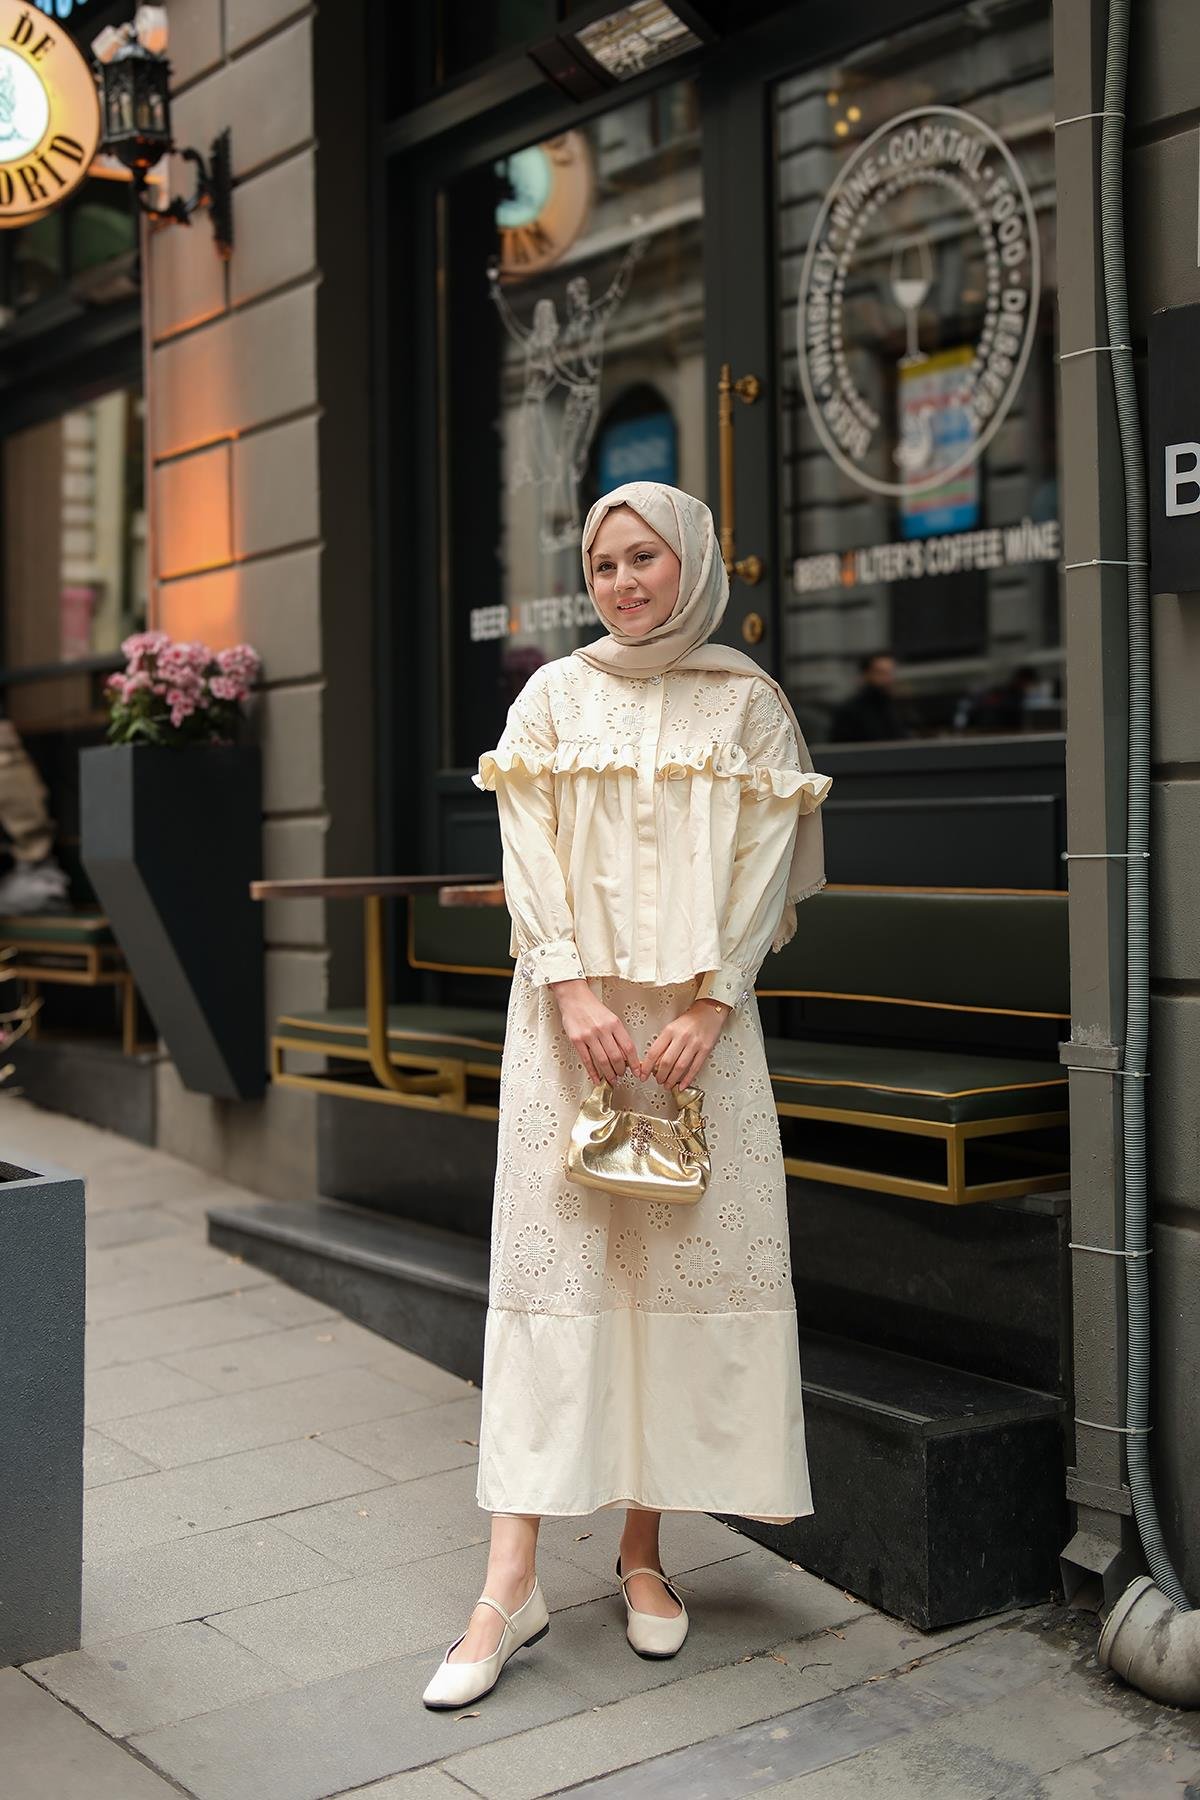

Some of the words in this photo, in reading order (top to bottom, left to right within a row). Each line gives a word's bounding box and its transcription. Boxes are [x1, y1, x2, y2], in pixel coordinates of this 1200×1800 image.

[10, 12, 56, 62] DE
[888, 125, 986, 182] COCKTAIL
[984, 174, 1027, 267] FOOD
[925, 528, 1002, 577] COFFEE
[470, 604, 509, 642] BEER
